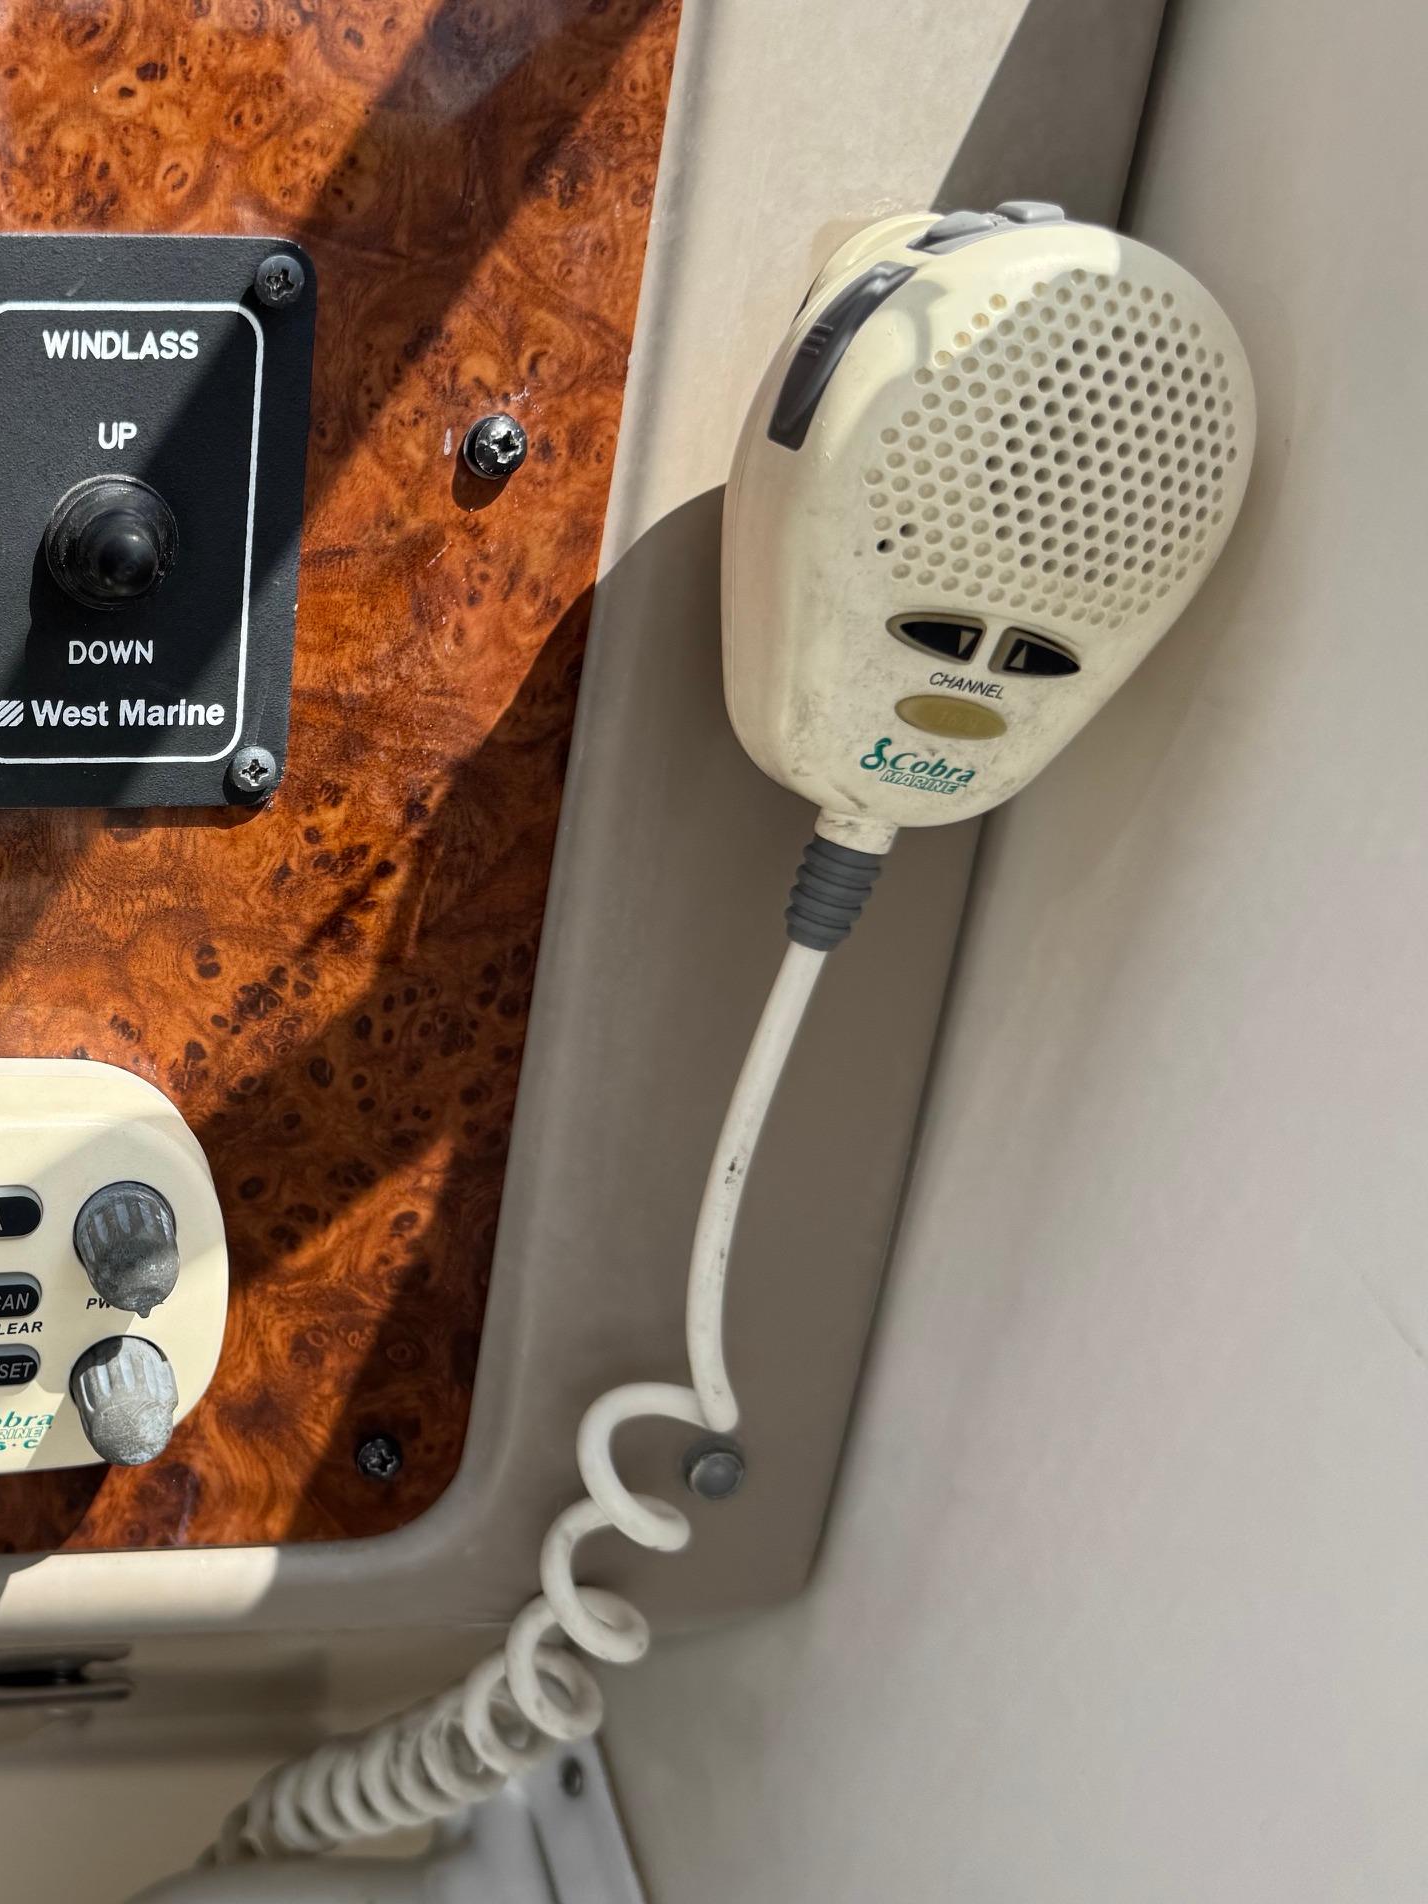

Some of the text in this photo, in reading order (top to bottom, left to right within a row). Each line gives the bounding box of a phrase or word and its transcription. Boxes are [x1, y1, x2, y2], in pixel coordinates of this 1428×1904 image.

[42, 330, 199, 360] WINDLASS
[97, 422, 137, 450] UP
[68, 640, 154, 665] DOWN
[928, 672, 1005, 700] CHANNEL
[31, 698, 225, 727] West Marine
[890, 753, 976, 783] Cobra
